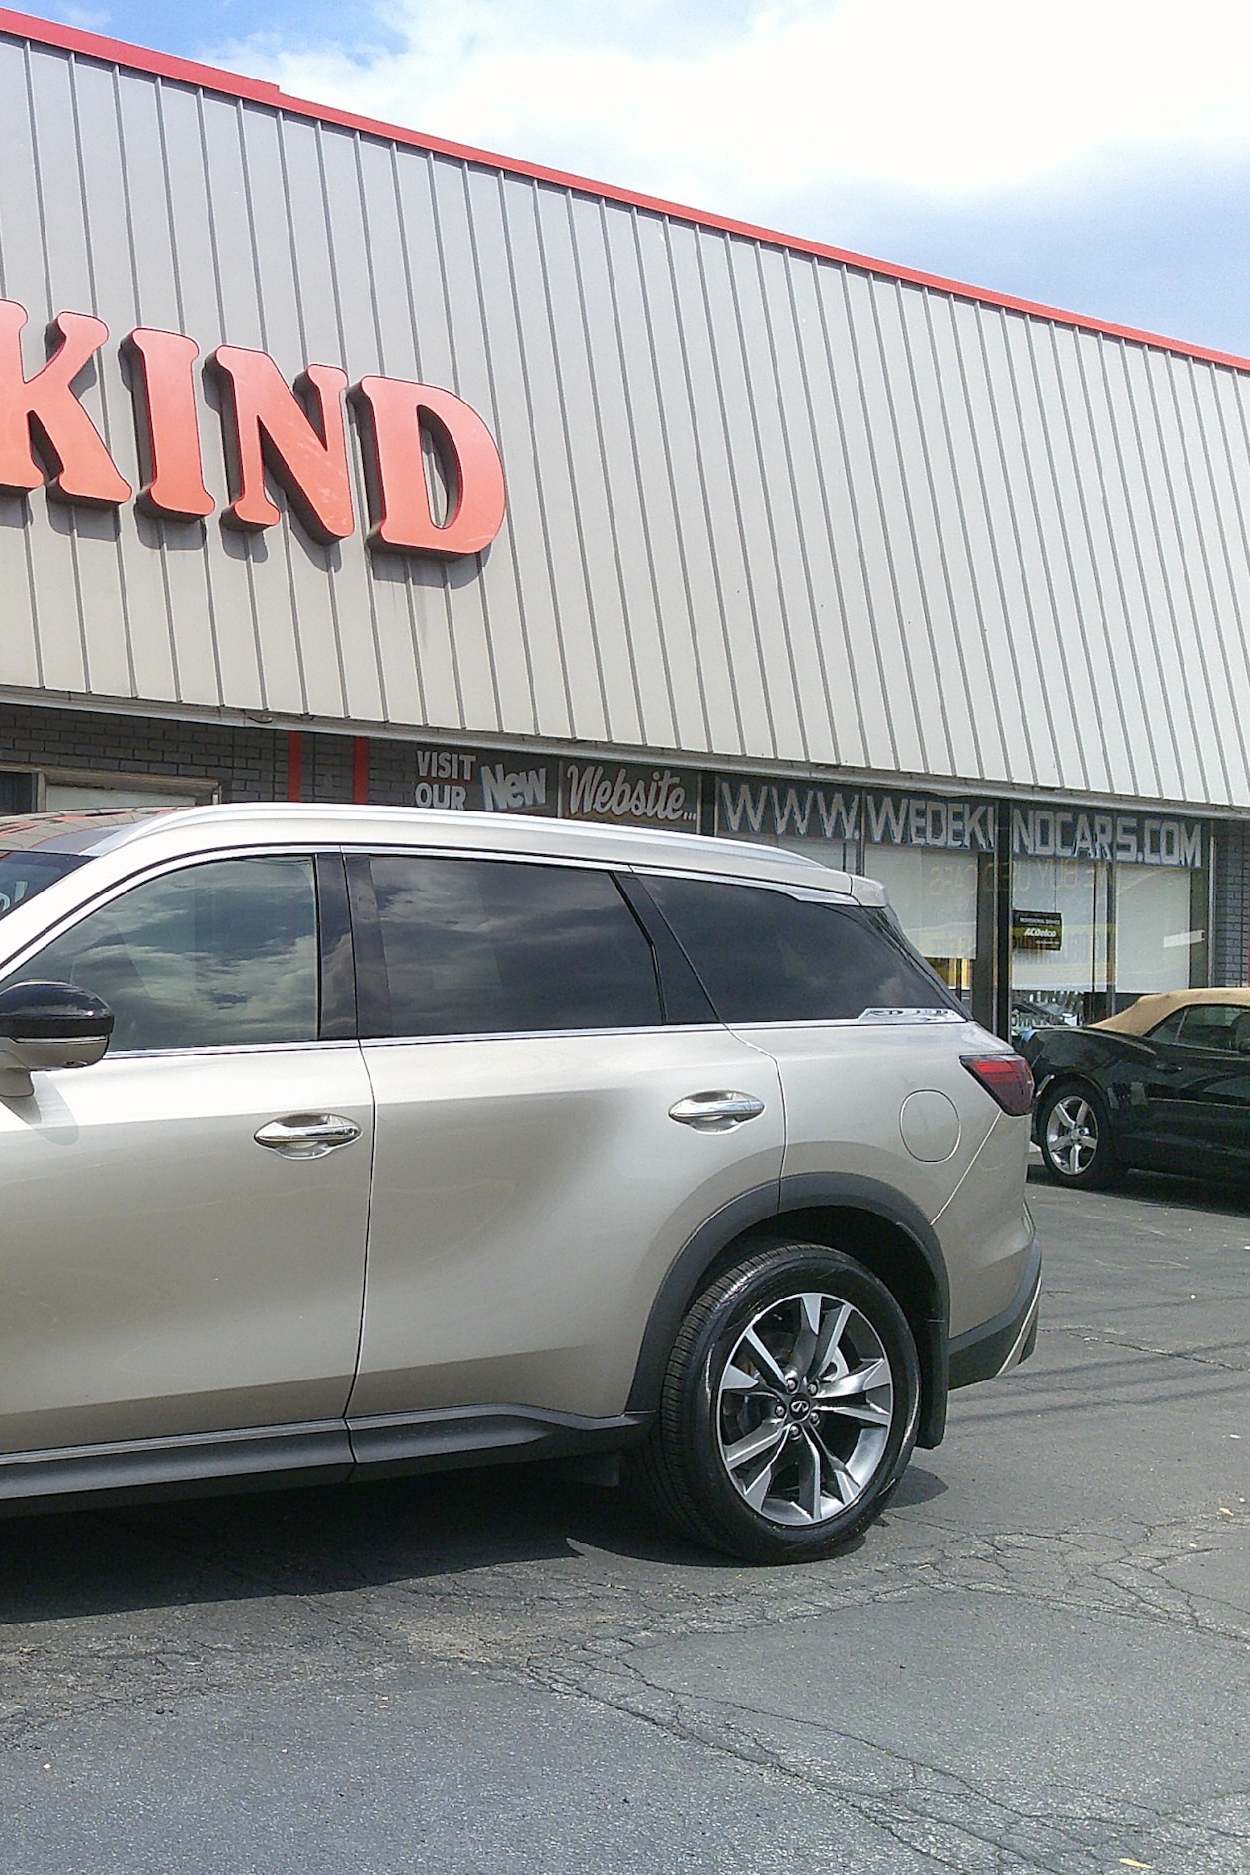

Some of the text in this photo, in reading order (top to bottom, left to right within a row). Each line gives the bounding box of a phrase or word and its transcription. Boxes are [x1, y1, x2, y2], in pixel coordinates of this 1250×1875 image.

[416, 750, 476, 780] VISIT
[415, 782, 466, 810] OUR
[480, 764, 546, 812] New
[1024, 927, 1057, 937] ACDelco
